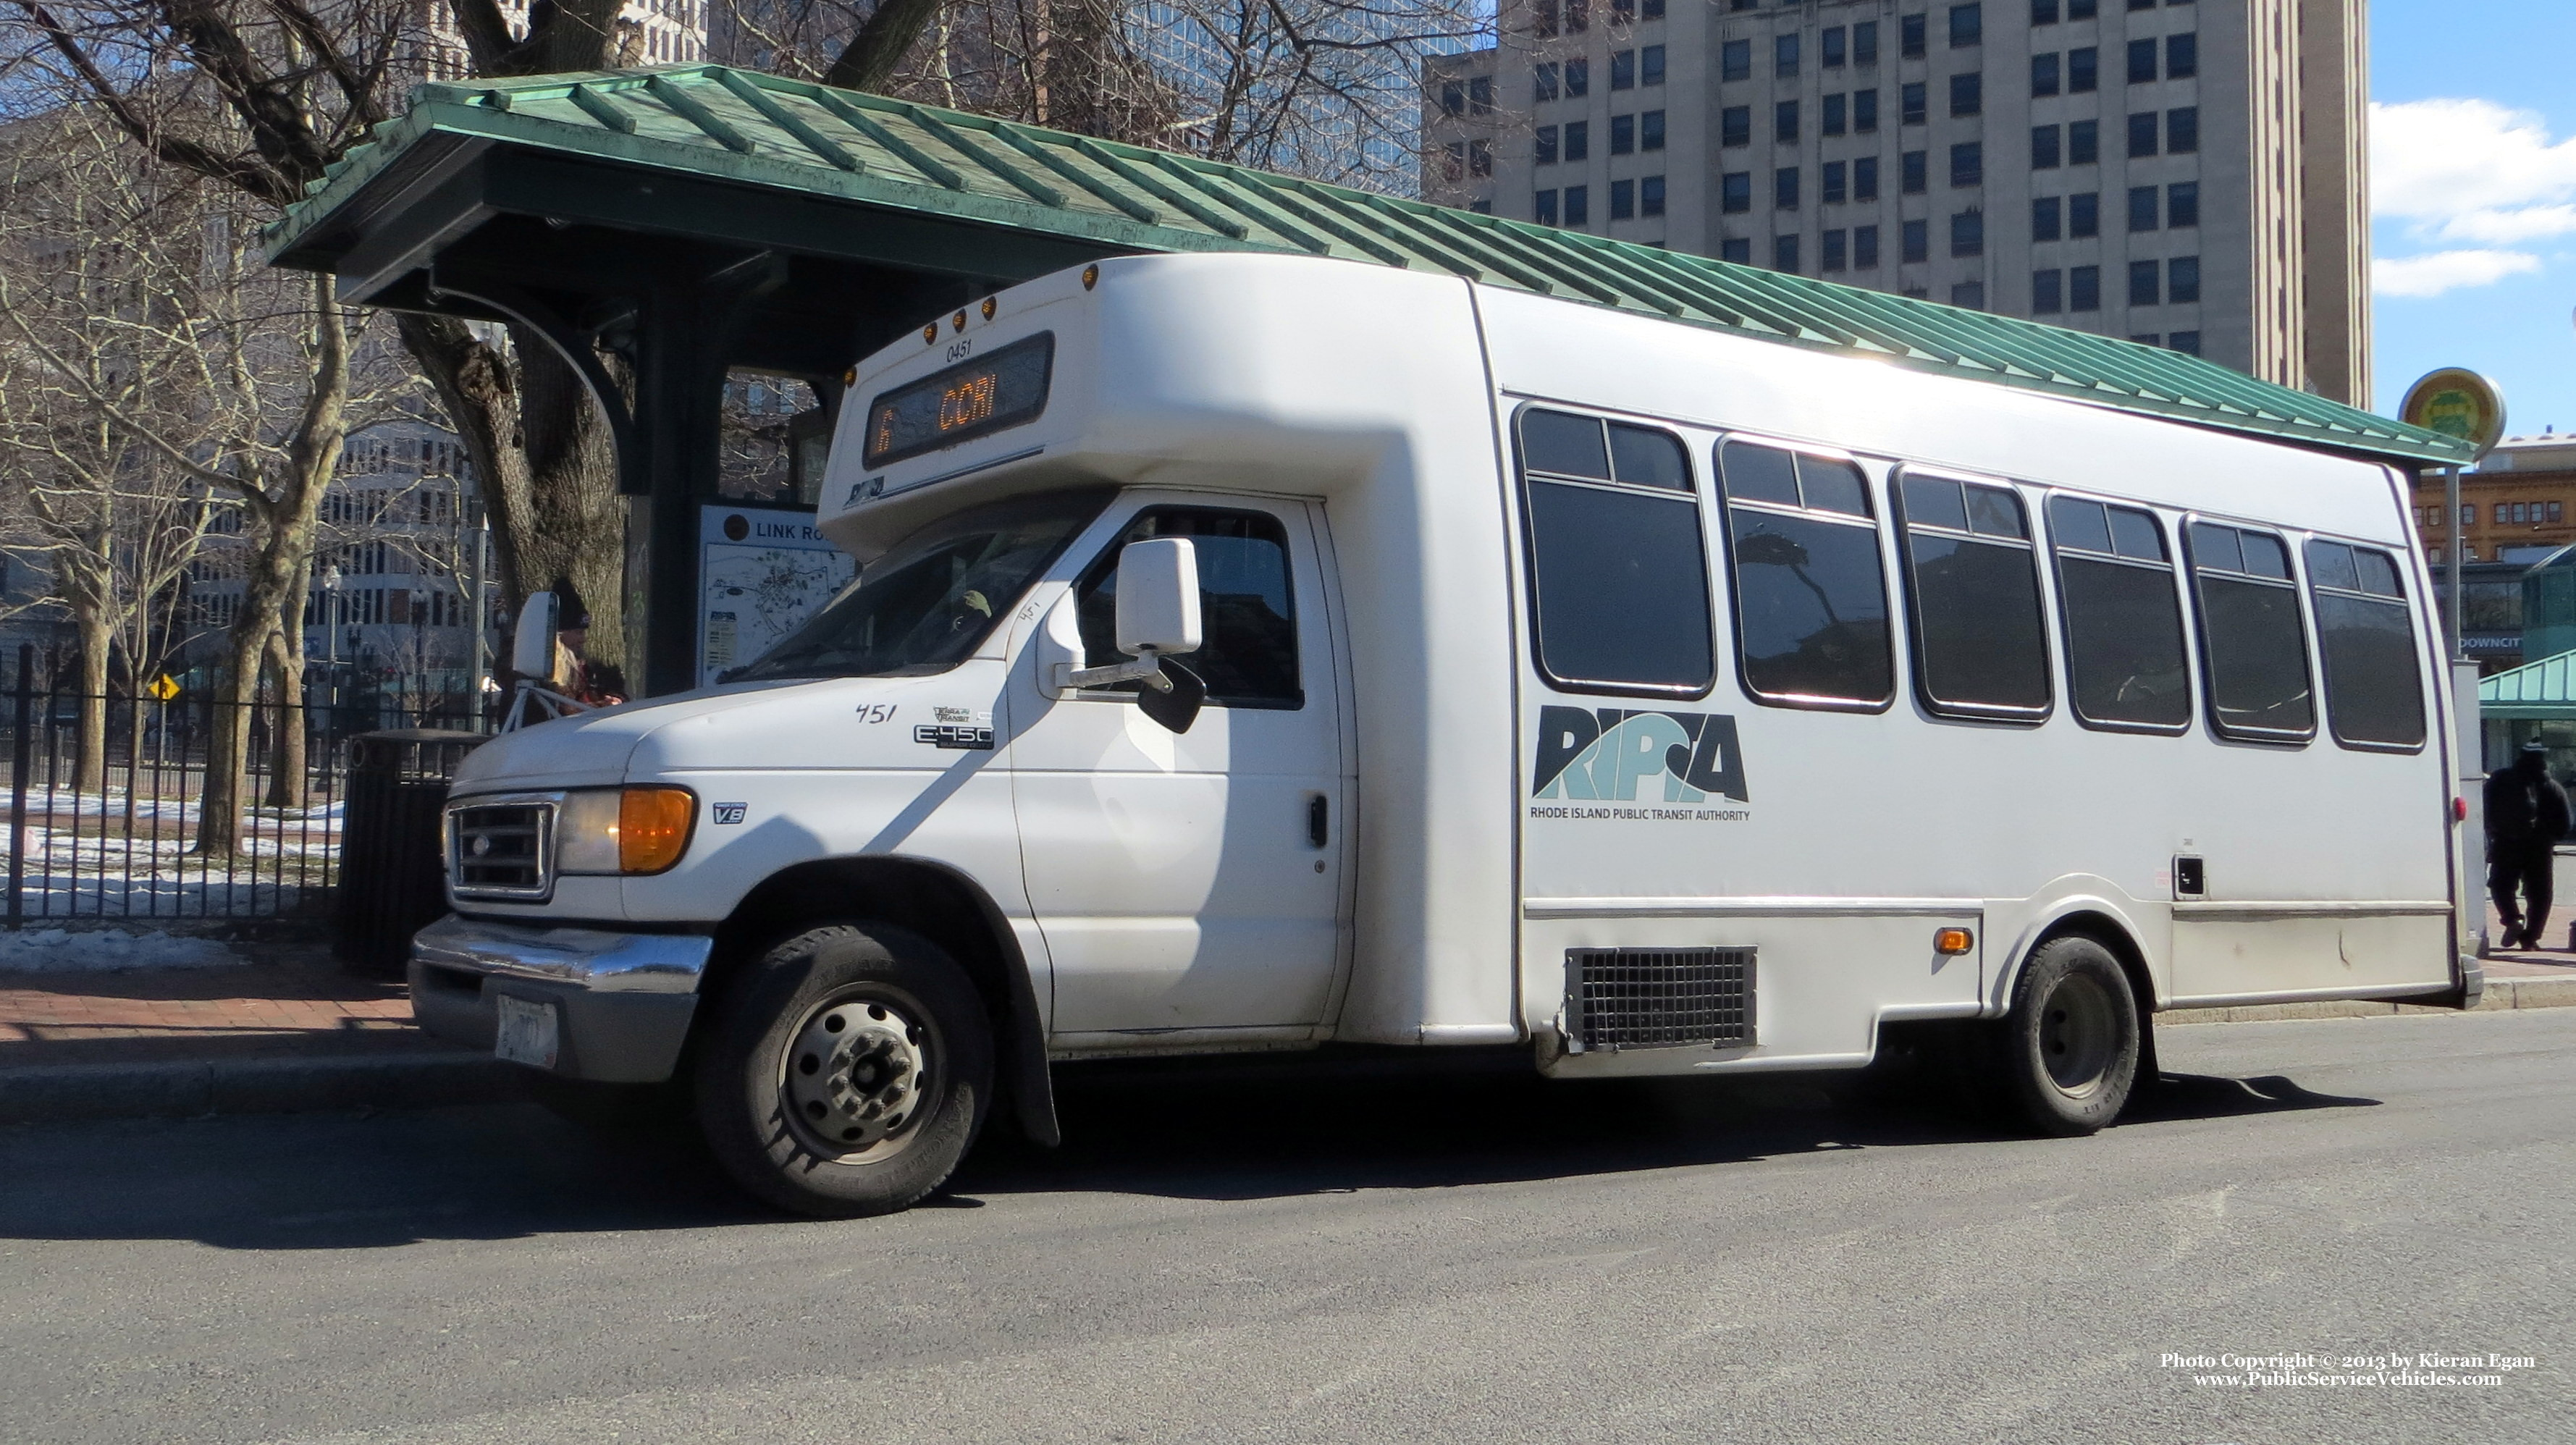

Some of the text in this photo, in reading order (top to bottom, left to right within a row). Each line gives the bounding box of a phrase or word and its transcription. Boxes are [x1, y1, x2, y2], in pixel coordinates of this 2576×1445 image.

[946, 339, 972, 362] 0451
[939, 373, 997, 431] CCRI
[757, 523, 830, 542] LINK RO
[1019, 602, 1041, 620] 451
[2459, 637, 2523, 648] DOWNCIT
[855, 704, 898, 725] 451
[1531, 704, 1749, 804] RIPTA
[715, 808, 745, 823] V8
[1531, 806, 1751, 821] RHODE ISLAND PUBLIC TRANSIT AUTHORITY
